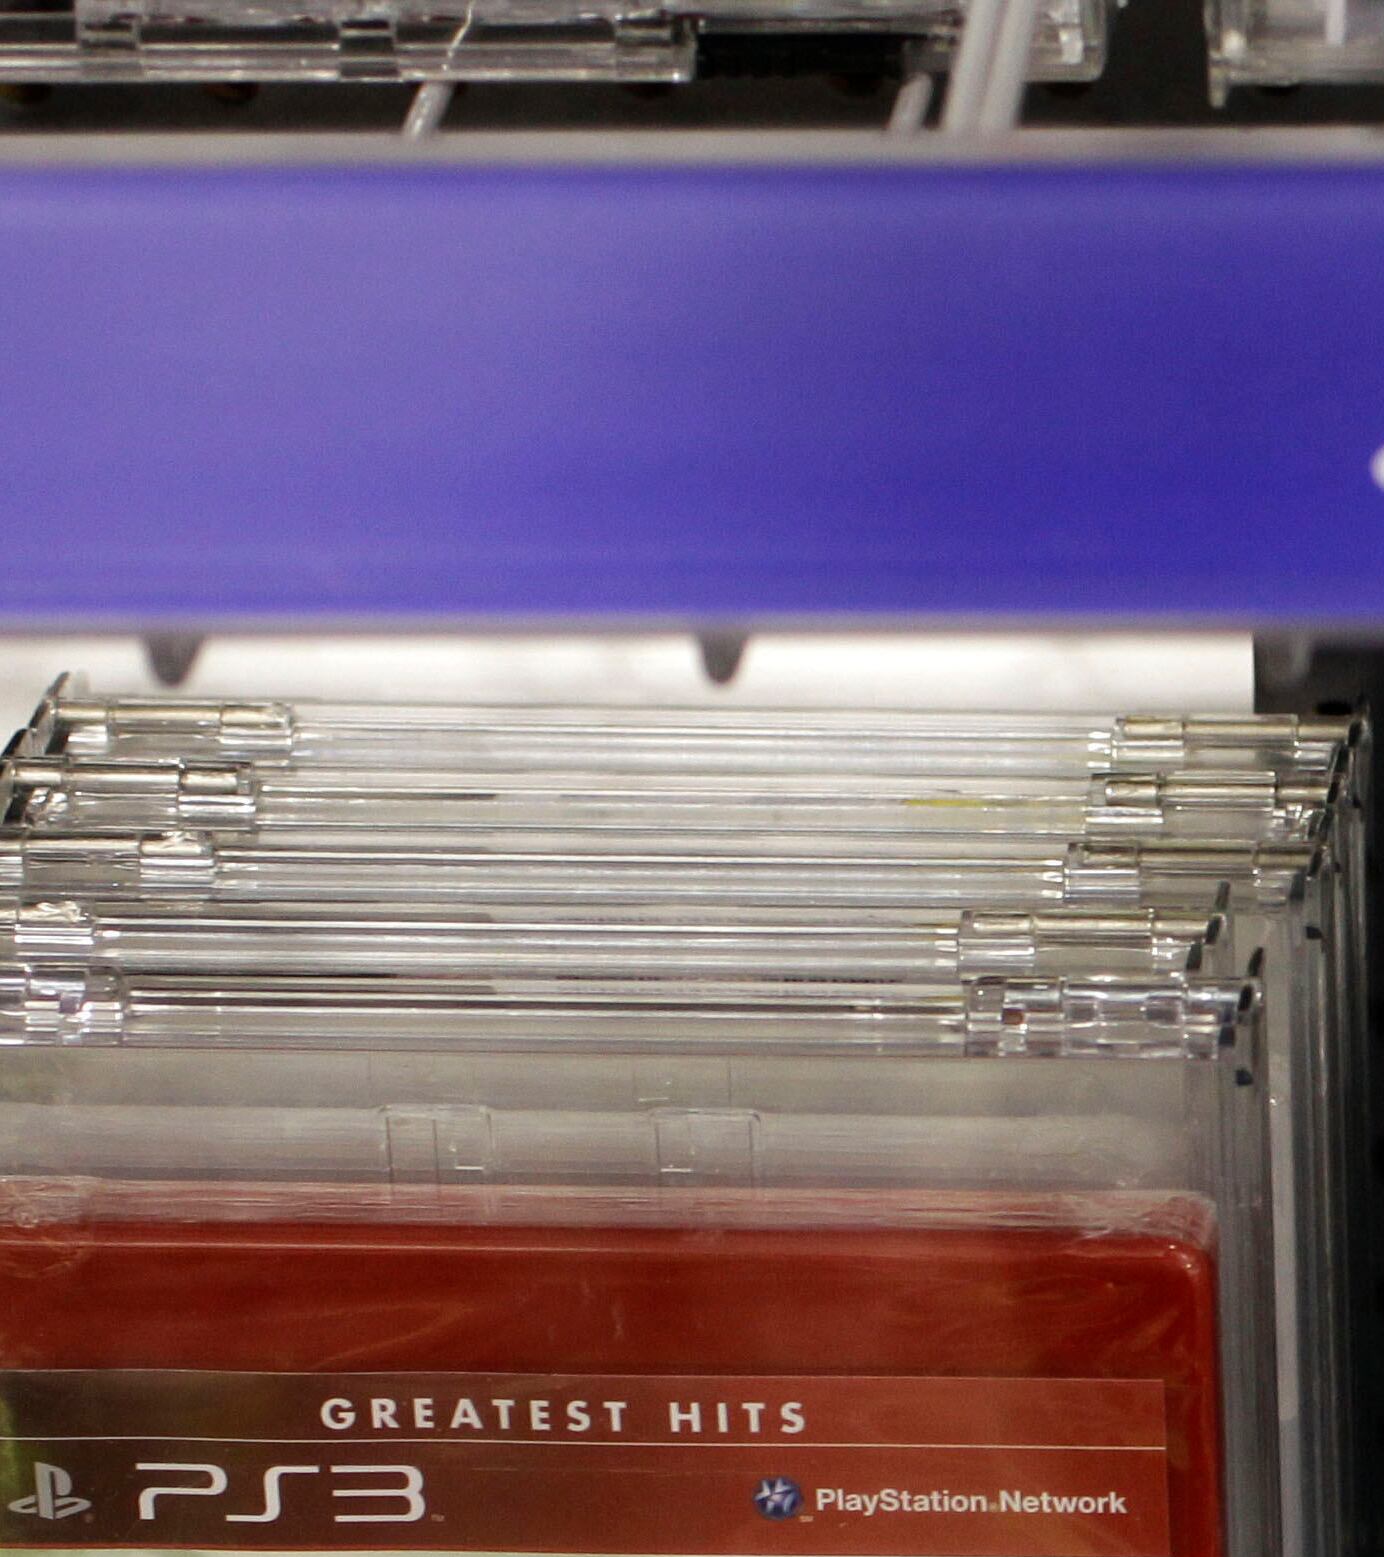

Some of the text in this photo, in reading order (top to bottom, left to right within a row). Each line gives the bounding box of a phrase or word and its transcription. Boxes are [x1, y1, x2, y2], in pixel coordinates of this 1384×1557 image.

[320, 1398, 805, 1433] GREATEST HITS
[136, 1463, 426, 1522] PS3
